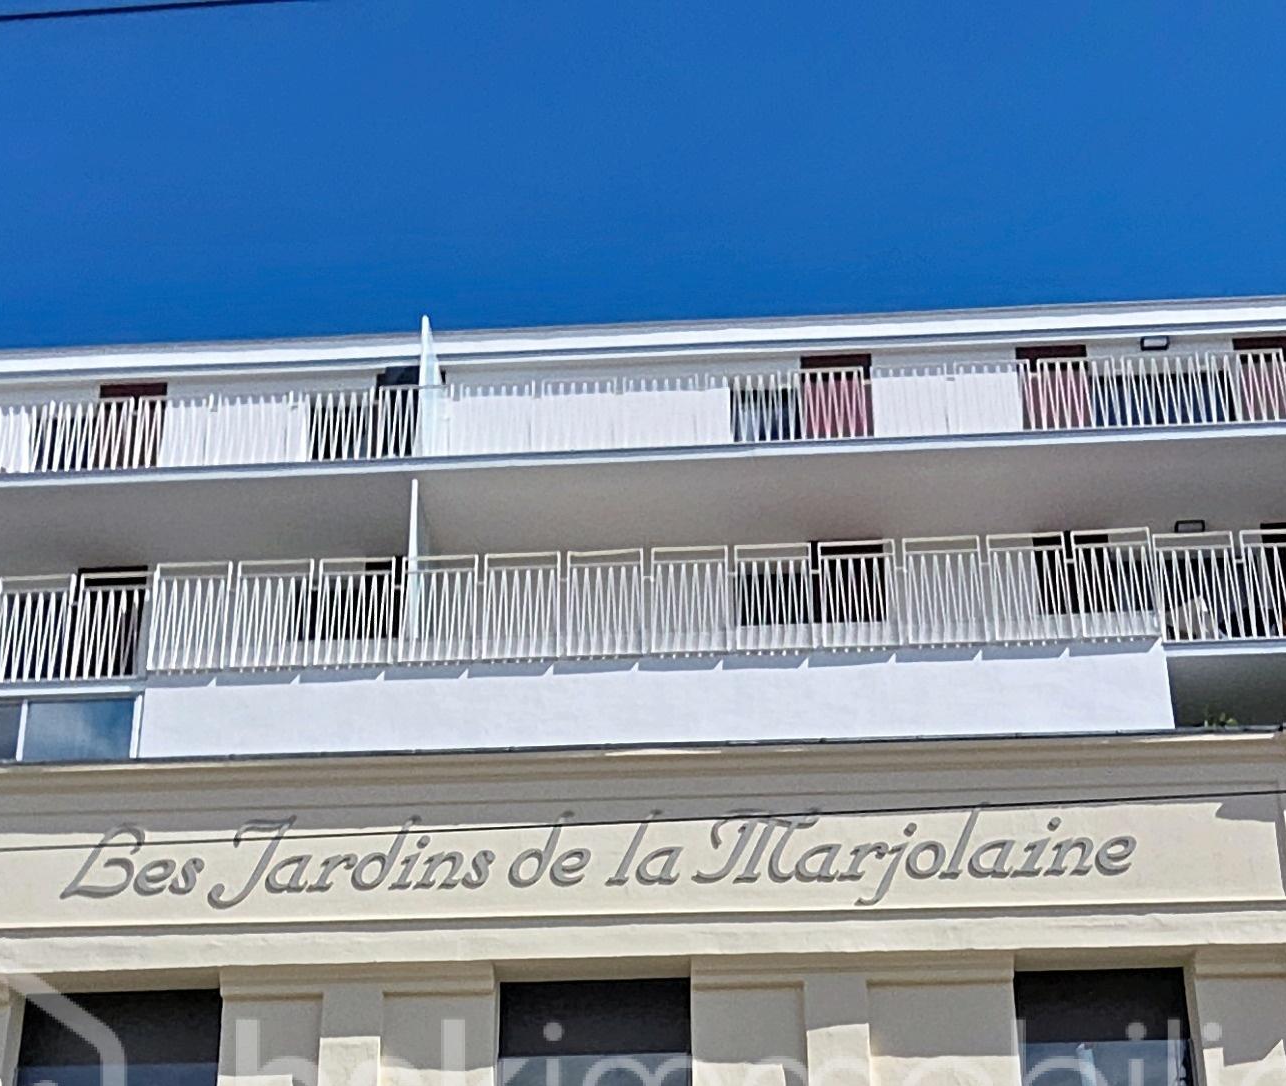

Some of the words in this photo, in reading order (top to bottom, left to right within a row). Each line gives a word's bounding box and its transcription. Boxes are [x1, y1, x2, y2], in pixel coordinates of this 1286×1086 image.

[59, 820, 205, 900] Les
[206, 815, 496, 910] Jardins
[507, 811, 592, 889] de
[605, 808, 684, 887] la
[690, 802, 1138, 907] Marjolaine
